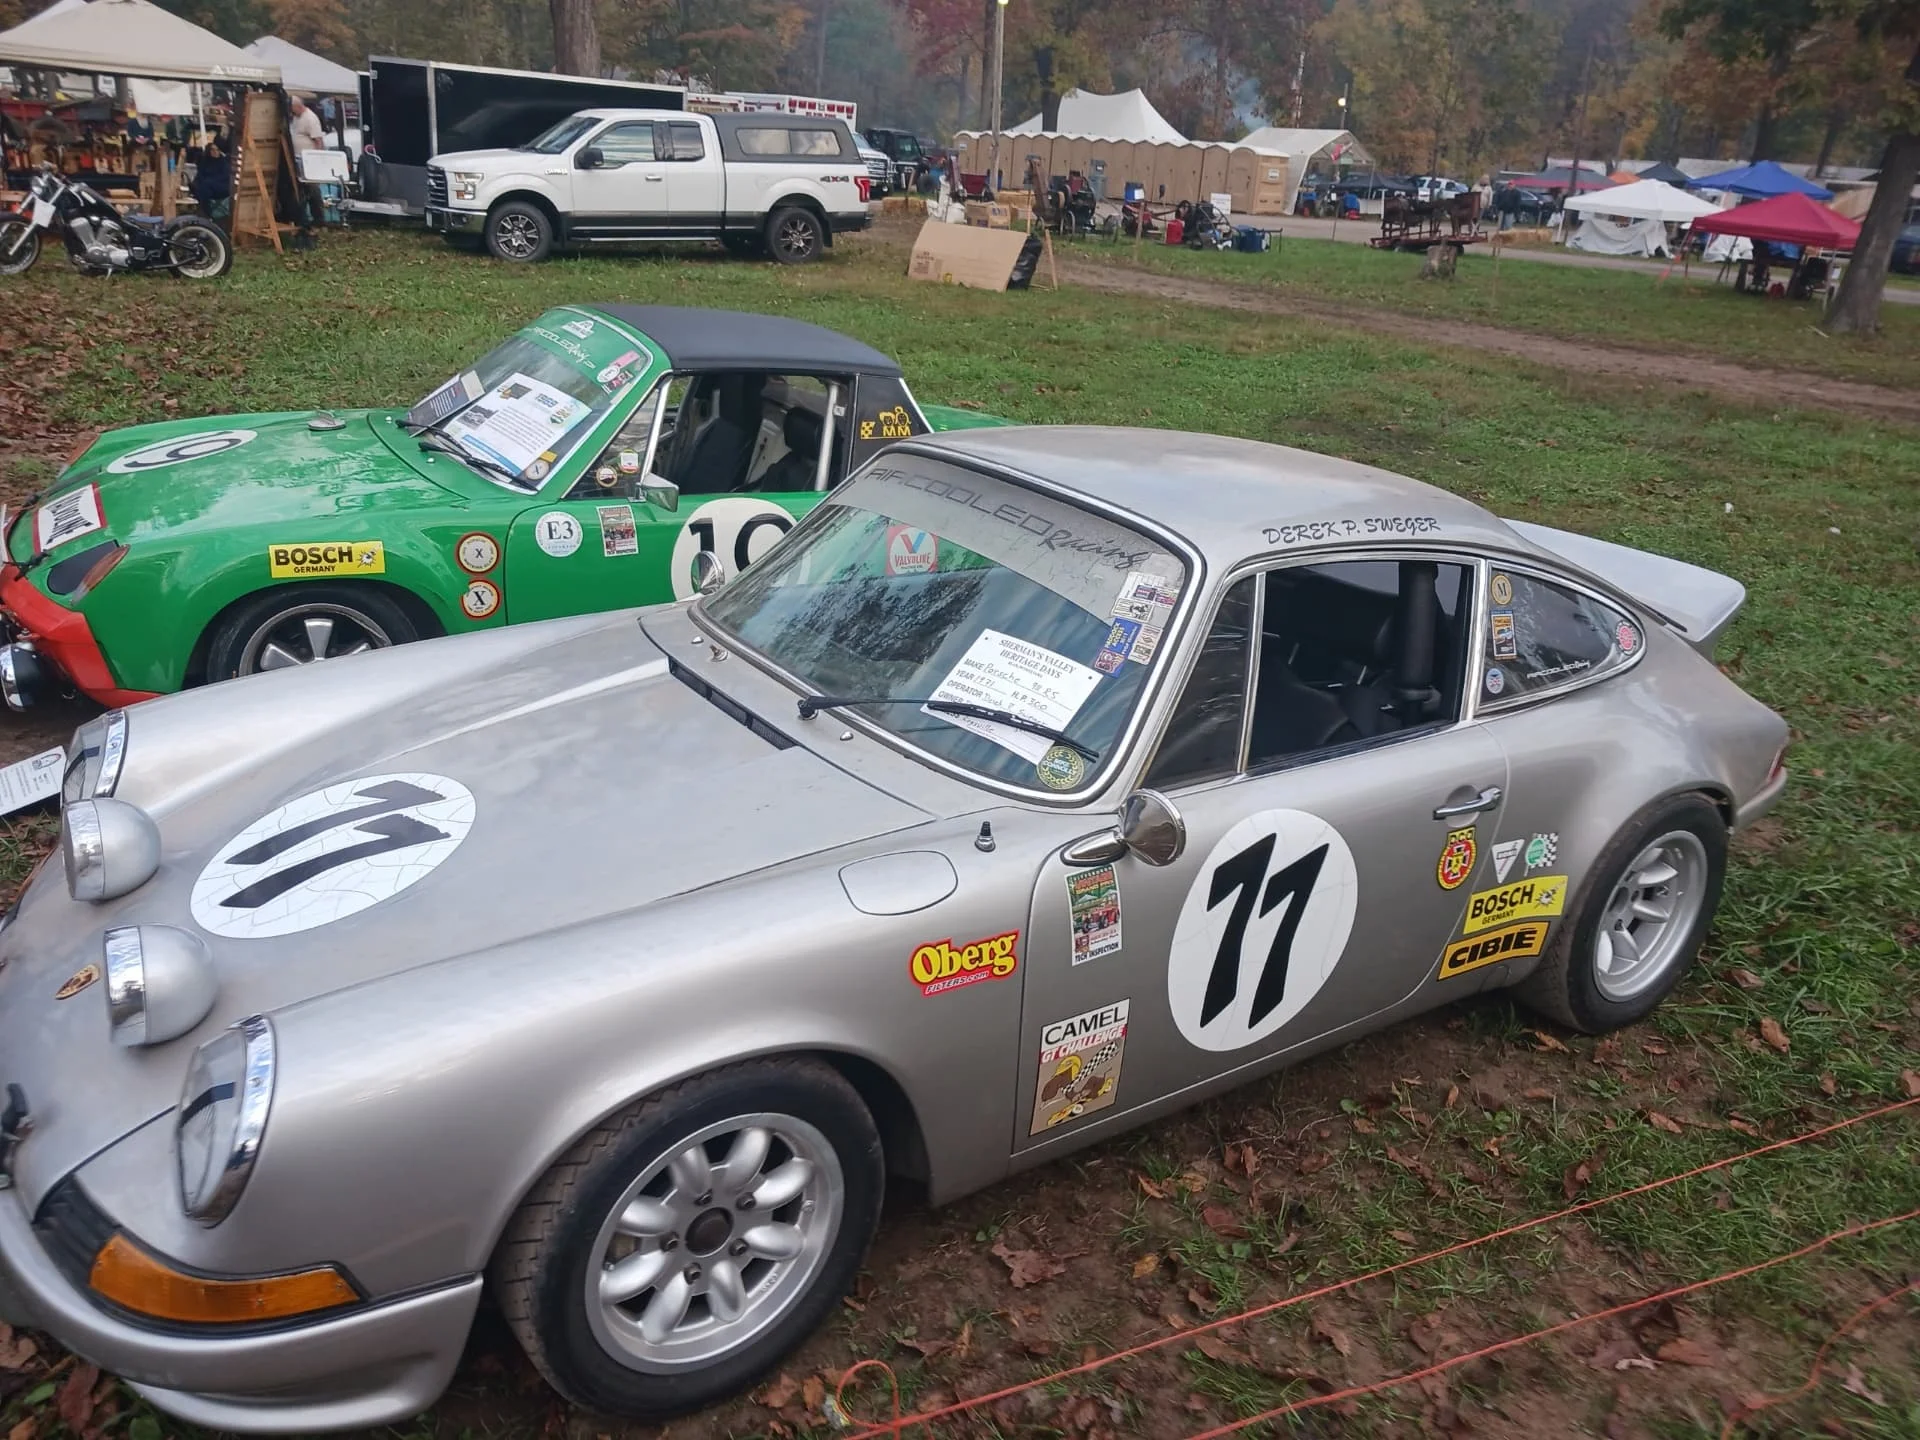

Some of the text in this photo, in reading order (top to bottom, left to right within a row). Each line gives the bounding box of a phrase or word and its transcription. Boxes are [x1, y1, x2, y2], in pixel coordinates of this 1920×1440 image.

[883, 426, 911, 436] MM
[546, 521, 574, 541] E3
[1262, 516, 1441, 545] DEREK P. SWEGER
[274, 546, 354, 567] BOSCH
[475, 548, 484, 558] X
[894, 552, 932, 567] VALVOLINE
[293, 565, 336, 574] GERMANY
[473, 590, 486, 606] X
[1497, 583, 1507, 598] M
[998, 639, 1045, 661] SHERMAN'S
[1045, 655, 1077, 675] VALLEY
[1000, 649, 1040, 670] HERITAGE
[1038, 664, 1063, 679] DAYS
[955, 669, 974, 682] YEAR
[964, 658, 985, 672] MAKE
[984, 661, 1021, 685] Porsche
[946, 680, 983, 699] OPERATOR
[220, 780, 451, 908] 11
[1470, 884, 1536, 920] BOSCH
[1481, 910, 1515, 925] GERMANY
[1201, 832, 1329, 1030] 11
[911, 935, 1017, 984] Oberg
[1074, 942, 1119, 963] TECH INSPECTION
[924, 971, 989, 995] FILTERS.com
[1045, 1007, 1126, 1045] CAMEL
[1041, 1025, 1127, 1063] GT CHALLENGE
